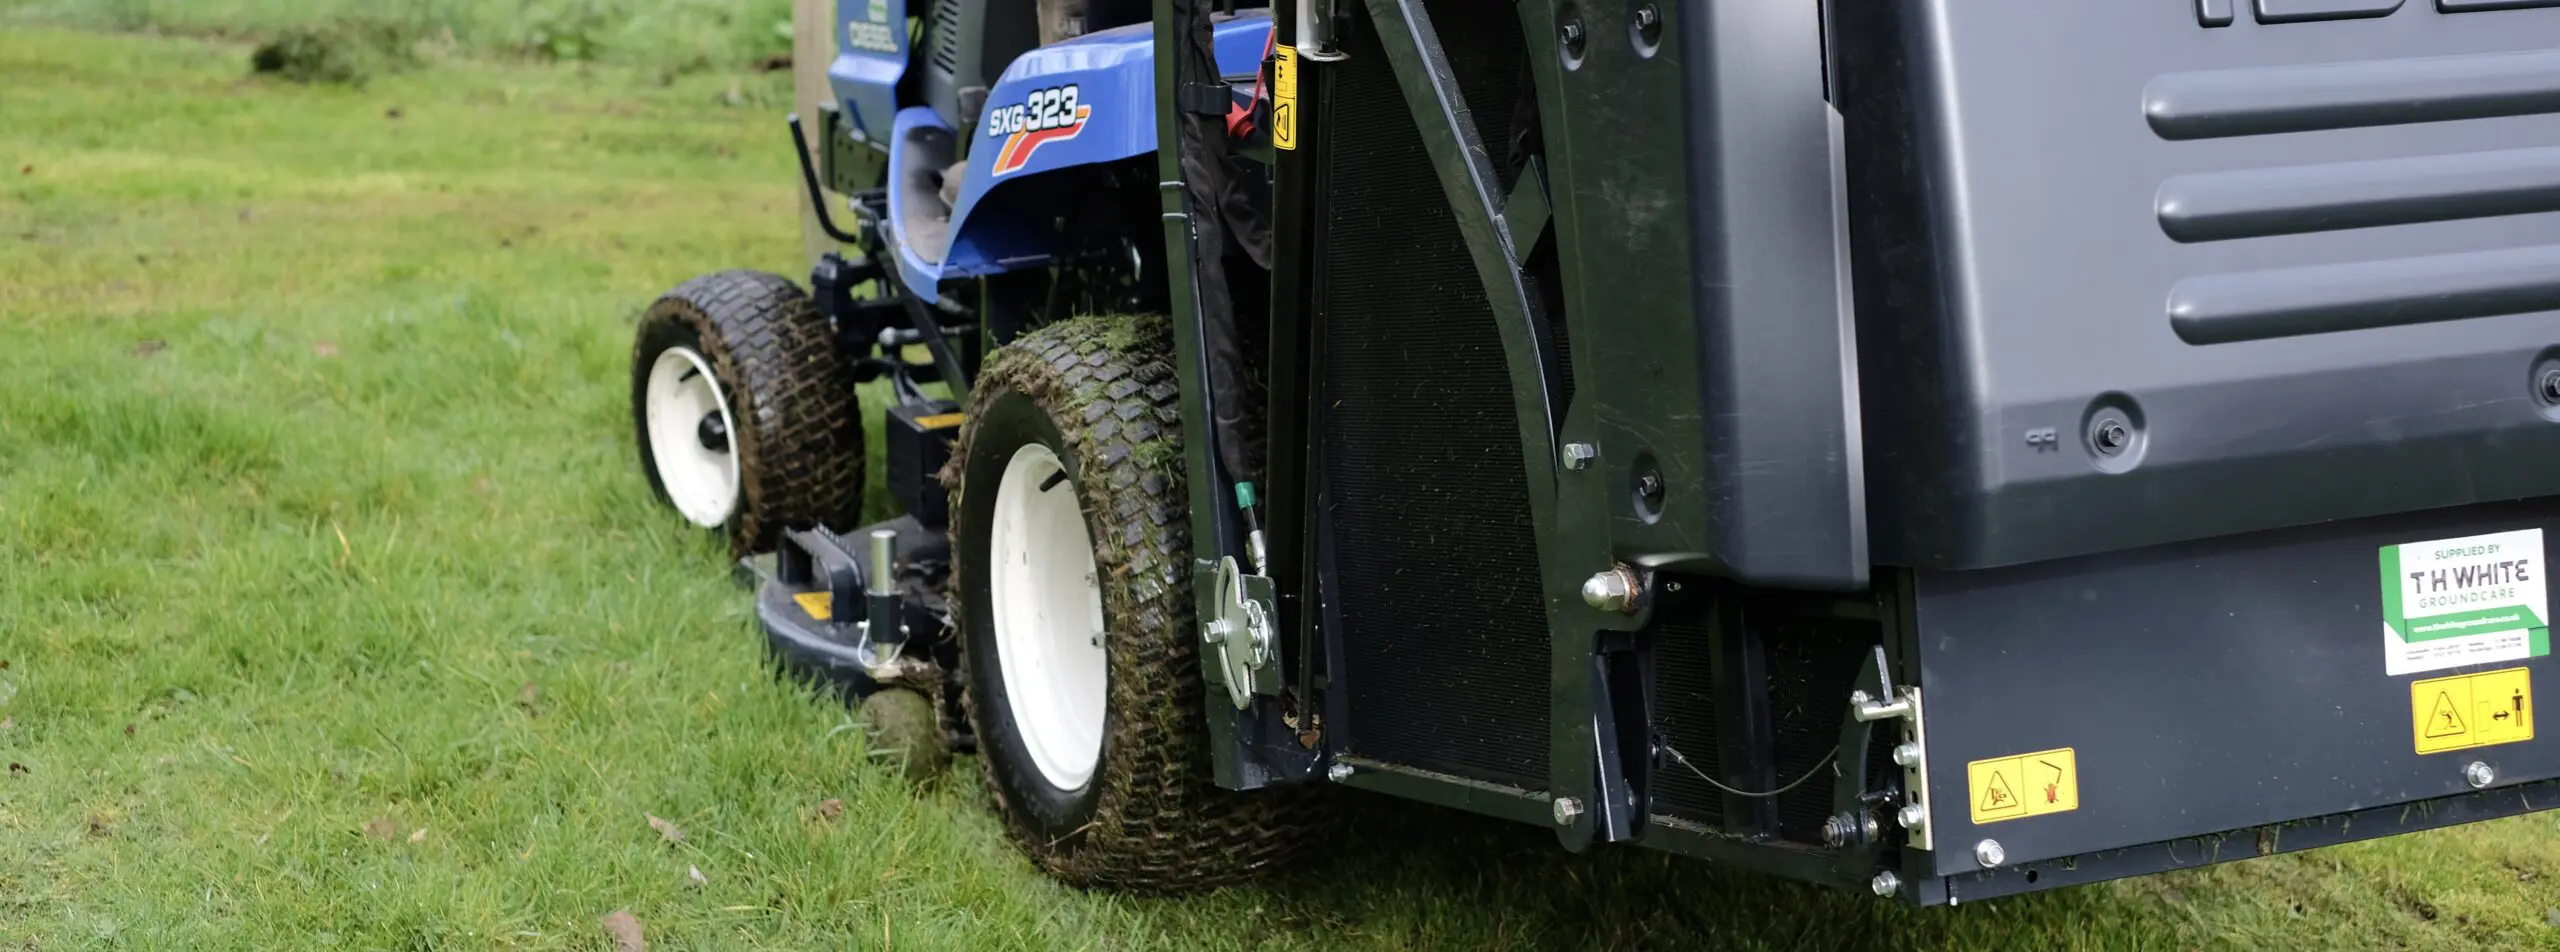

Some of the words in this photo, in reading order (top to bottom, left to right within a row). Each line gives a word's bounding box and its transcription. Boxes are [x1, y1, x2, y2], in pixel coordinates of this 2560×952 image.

[988, 103, 1024, 137] SXG
[1026, 84, 1079, 132] 323
[2435, 545, 2485, 560] SUPPLIED
[2488, 544, 2500, 554] BY
[2453, 559, 2529, 589] WHITE
[2419, 587, 2516, 609] GROUNDCARE
